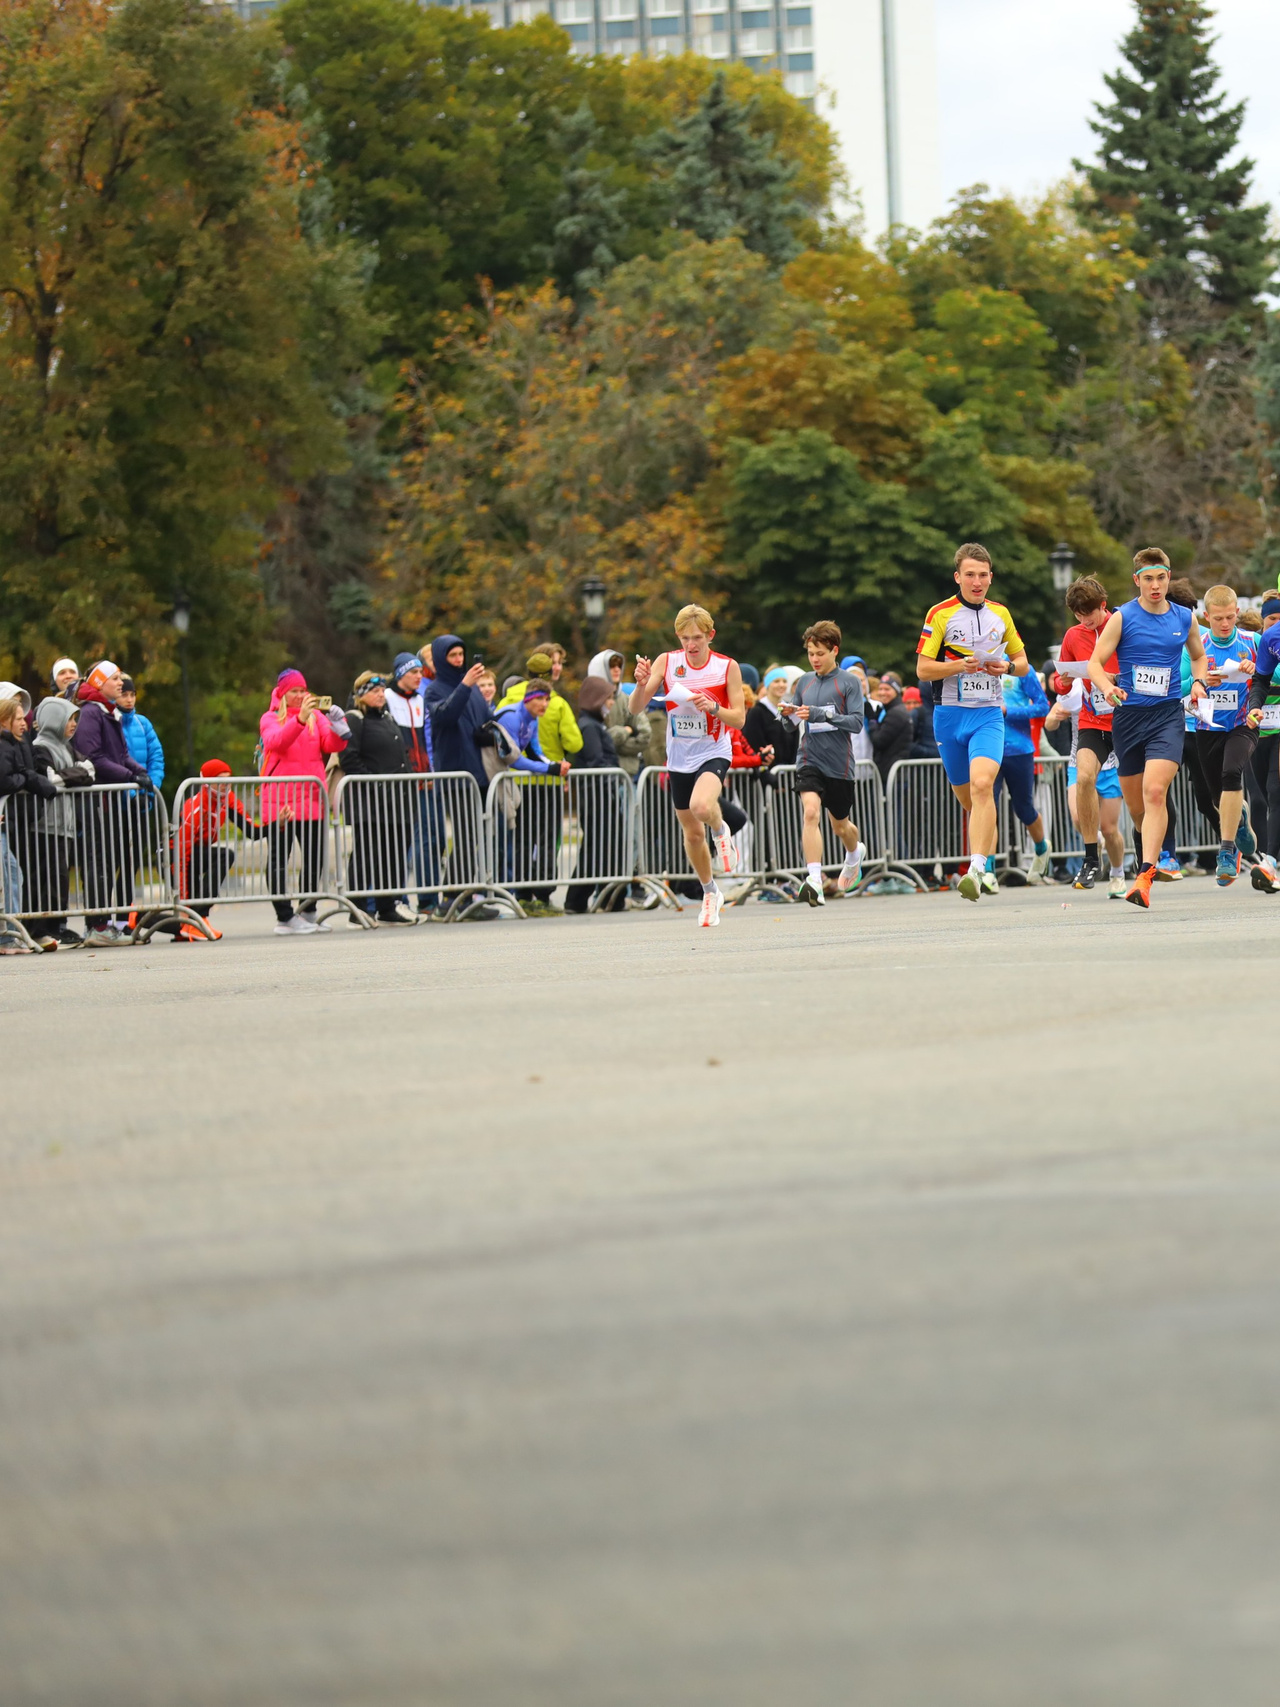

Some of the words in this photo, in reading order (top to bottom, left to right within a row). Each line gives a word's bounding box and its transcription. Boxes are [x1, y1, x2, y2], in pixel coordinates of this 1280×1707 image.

[1136, 672, 1165, 685] 220.1
[963, 681, 990, 691] 236.1
[677, 721, 702, 730] 229.1
